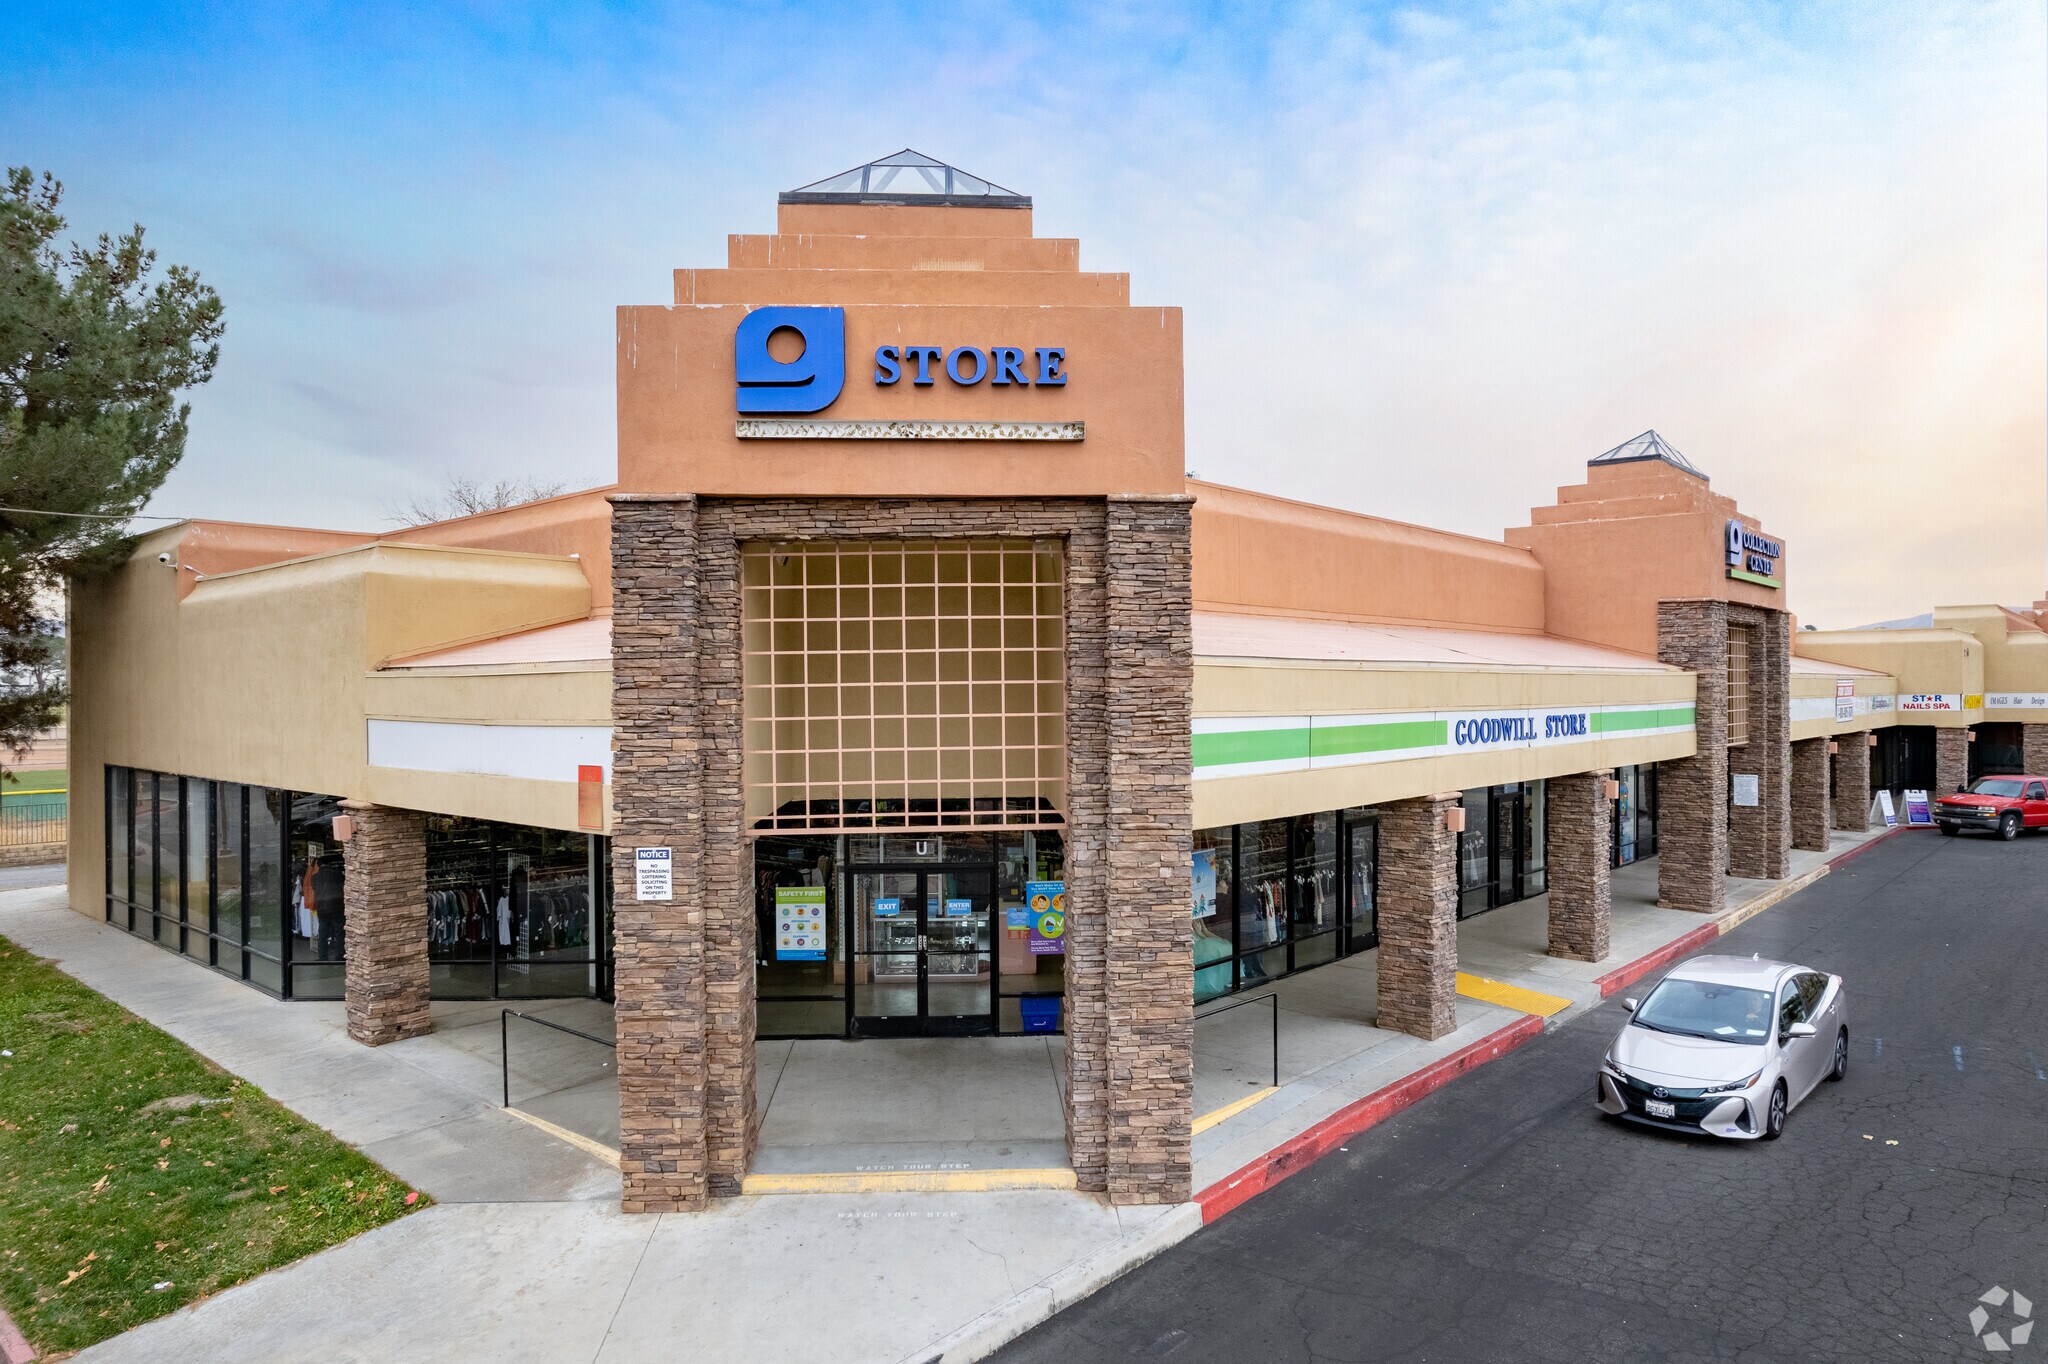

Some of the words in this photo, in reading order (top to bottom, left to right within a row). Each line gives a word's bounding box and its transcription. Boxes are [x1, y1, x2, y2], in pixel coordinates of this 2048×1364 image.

[874, 345, 1067, 386] STORE
[1742, 531, 1780, 558] COLLECTION
[1747, 555, 1774, 576] CENTER
[1990, 696, 2008, 705] IMAGES
[2013, 696, 2023, 705] Hair
[2031, 696, 2045, 706] Design
[1455, 717, 1537, 746] GOODWILL
[1545, 713, 1586, 738] STORE
[916, 841, 928, 855] U
